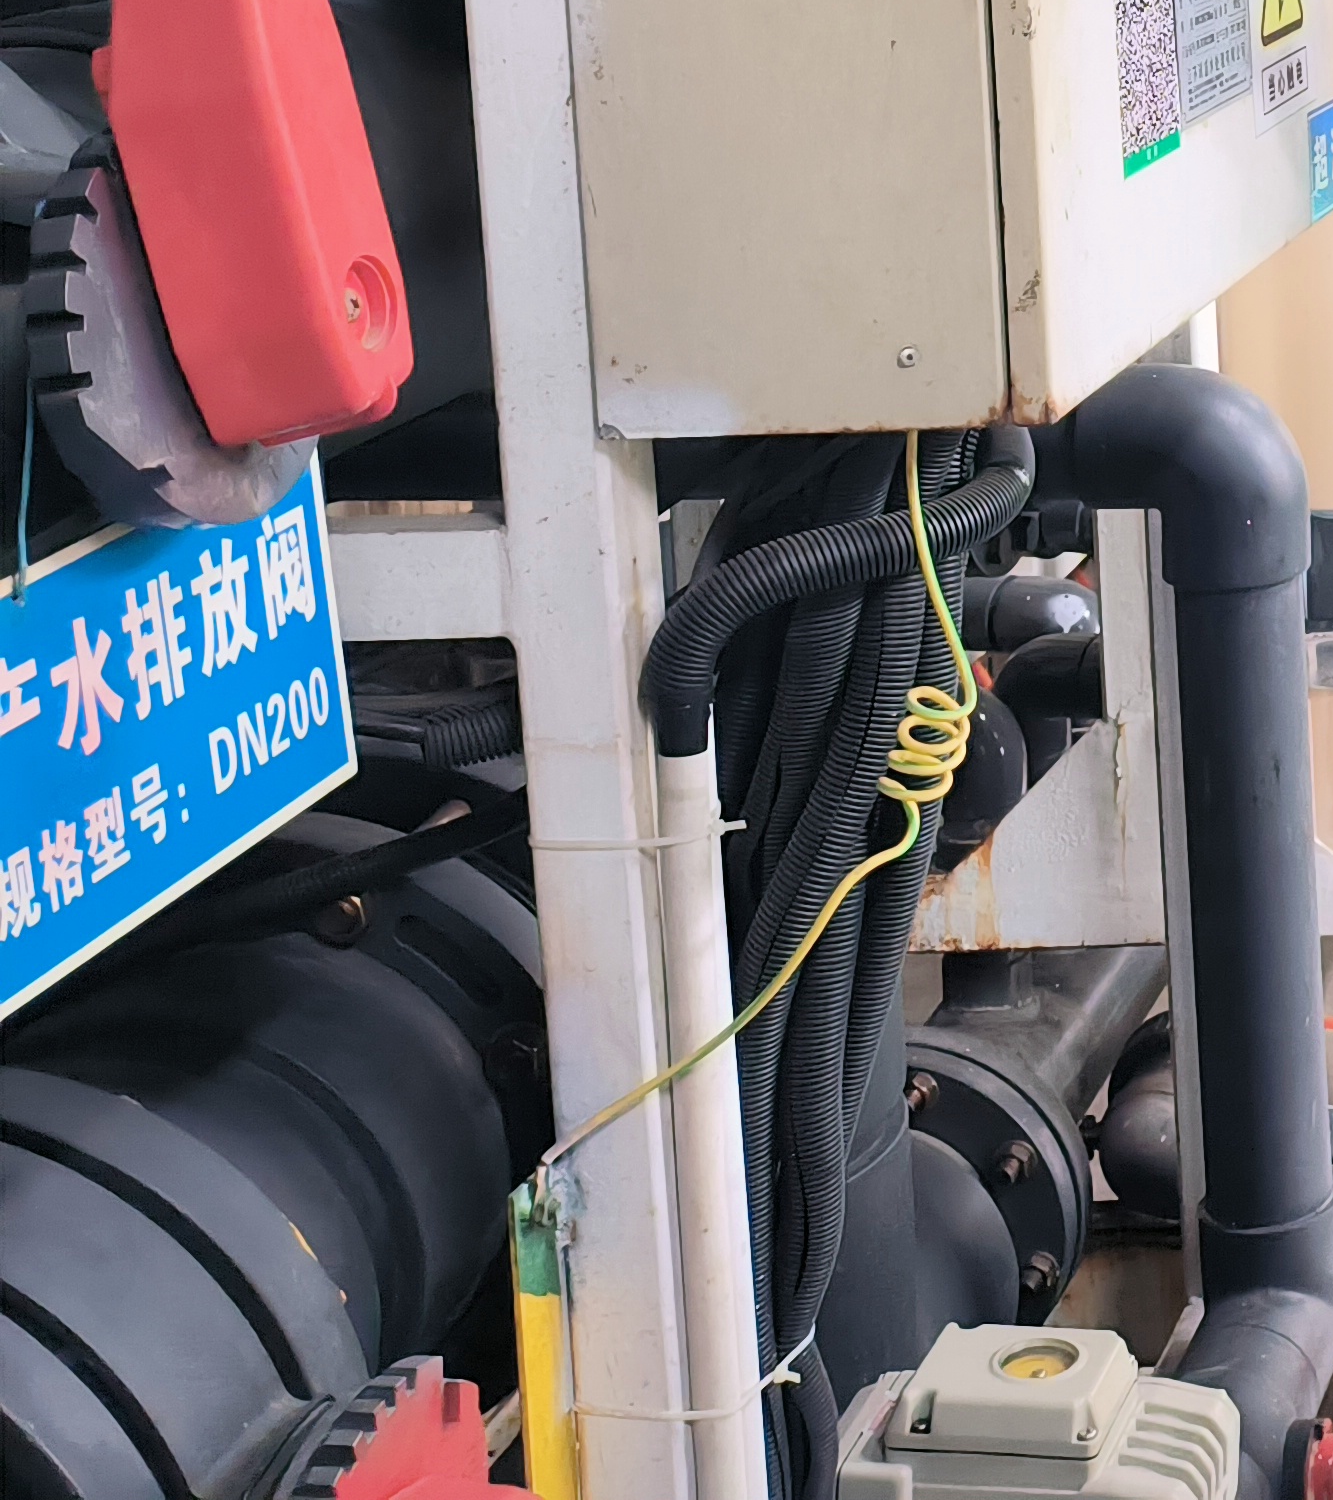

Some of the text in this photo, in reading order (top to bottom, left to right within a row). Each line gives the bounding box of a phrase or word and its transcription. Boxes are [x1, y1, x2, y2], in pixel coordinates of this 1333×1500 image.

[0, 503, 317, 757] 产水排放阀
[209, 666, 330, 795] DN200
